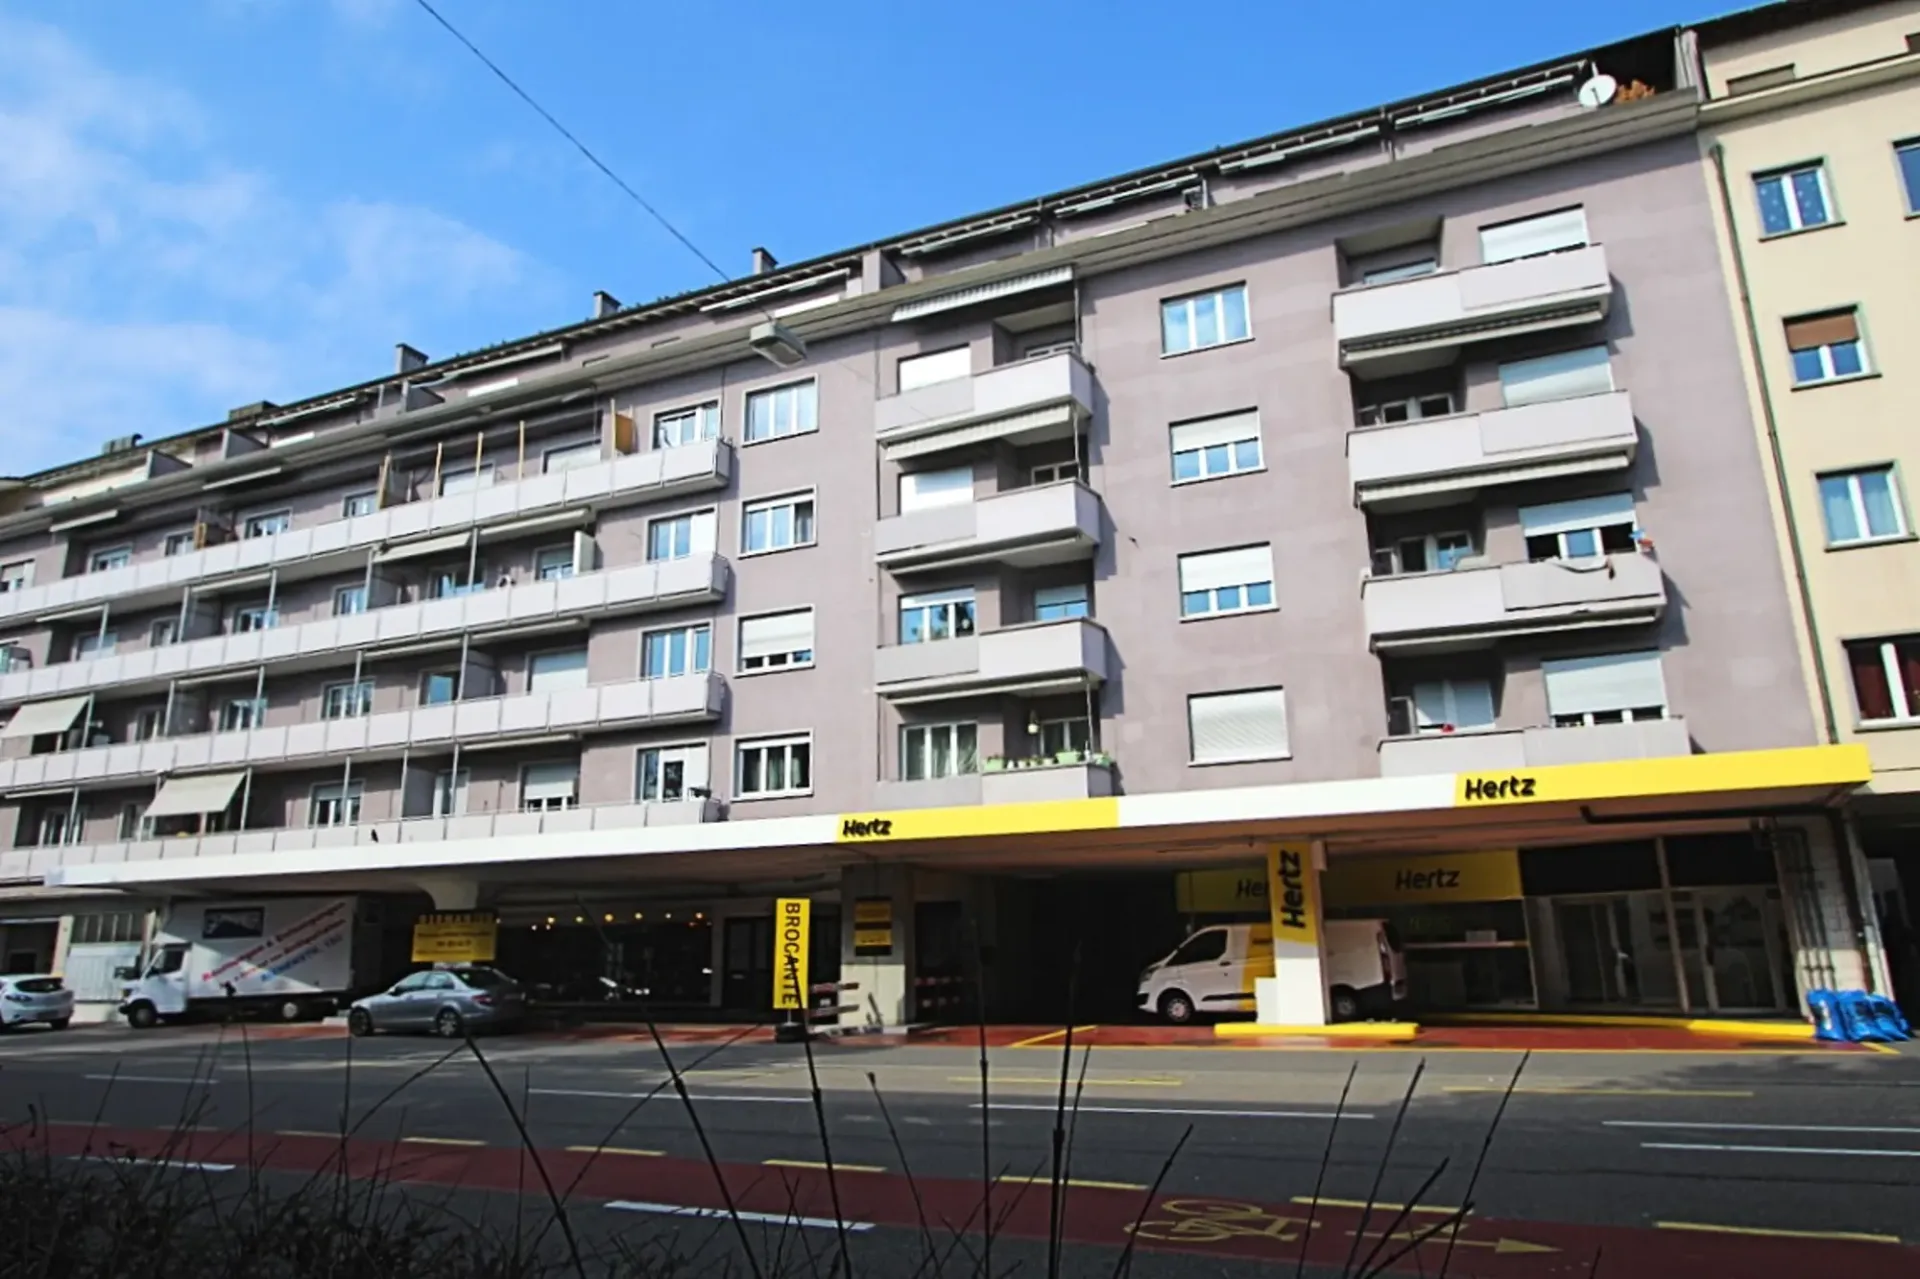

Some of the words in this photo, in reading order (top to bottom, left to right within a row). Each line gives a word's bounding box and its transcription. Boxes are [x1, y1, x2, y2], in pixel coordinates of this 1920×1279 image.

[1465, 775, 1536, 800] Hertz
[843, 818, 892, 836] Hertz
[1278, 850, 1305, 929] Hertz
[1394, 867, 1460, 891] Hertz
[782, 902, 801, 1005] BROCANTE
